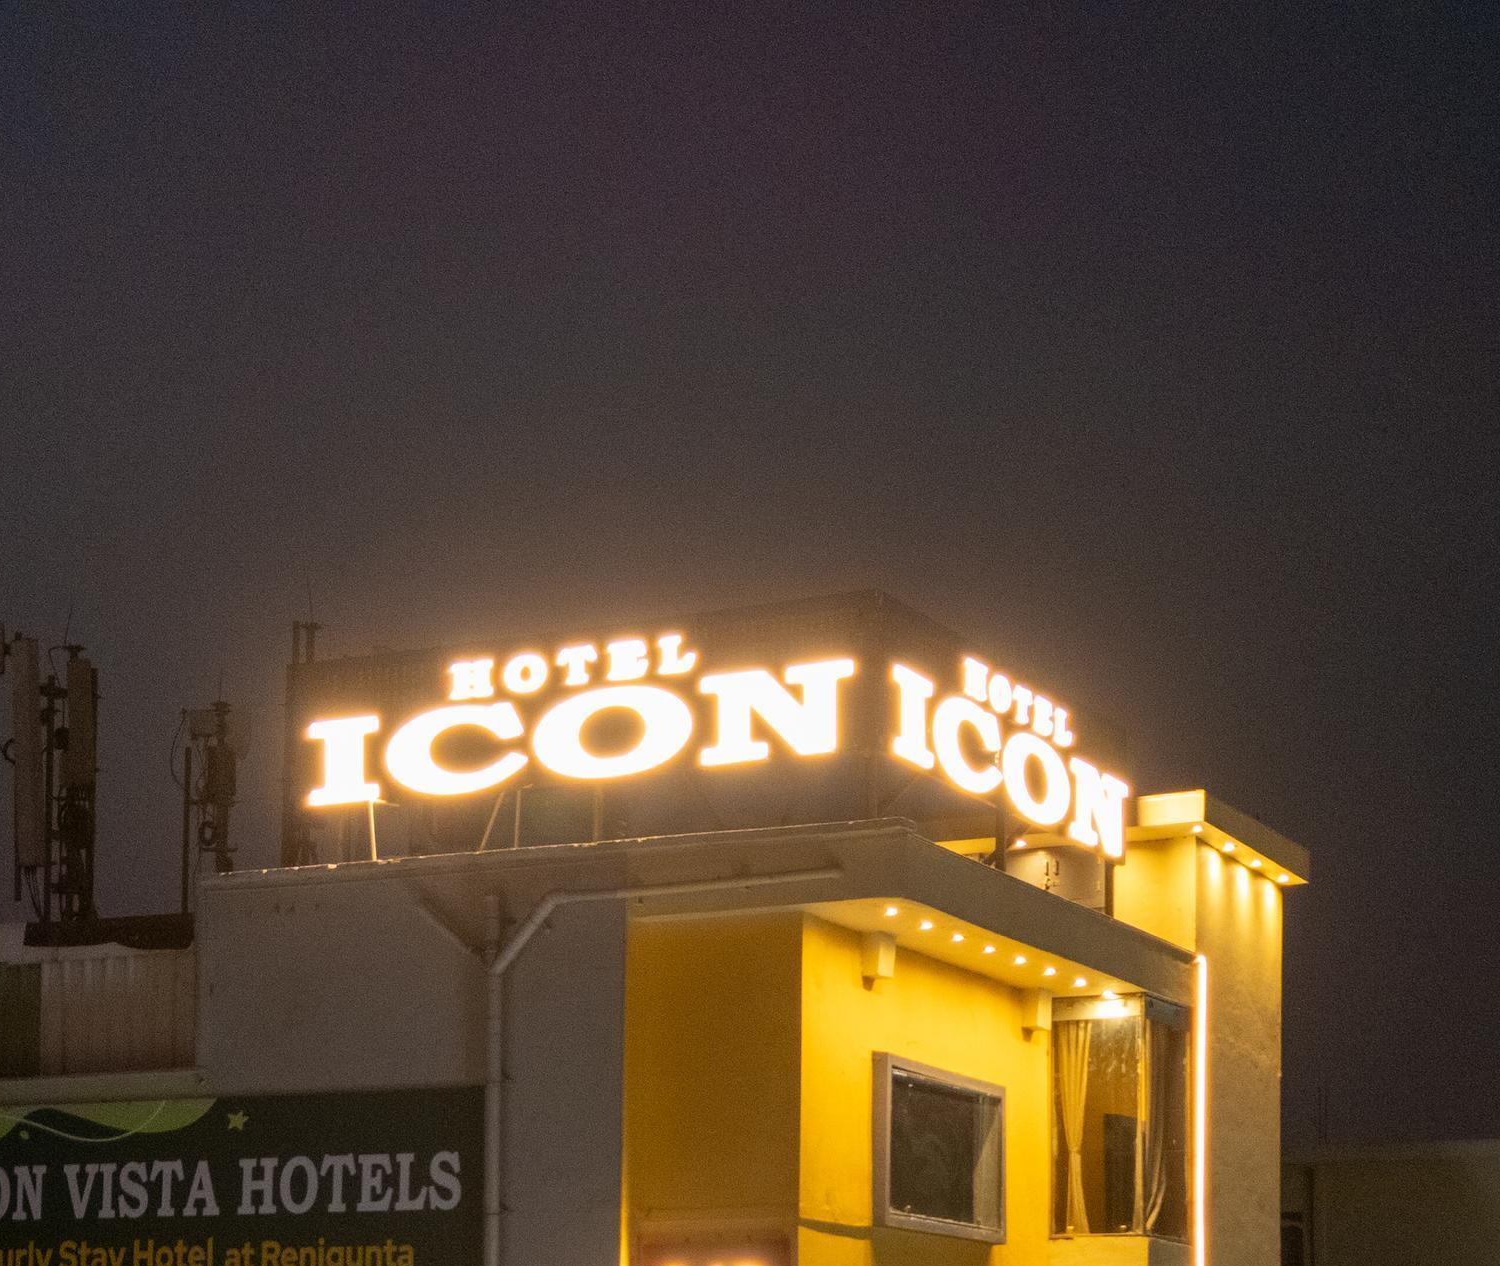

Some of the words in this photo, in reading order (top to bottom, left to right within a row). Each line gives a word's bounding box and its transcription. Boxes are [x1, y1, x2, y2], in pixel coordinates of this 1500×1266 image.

[447, 632, 698, 701] HOTEL
[963, 656, 1073, 748] HOTEL
[306, 658, 855, 808] ICON
[893, 663, 1130, 862] ICON
[63, 1158, 221, 1220] VISTA
[237, 1150, 464, 1217] HOTELS
